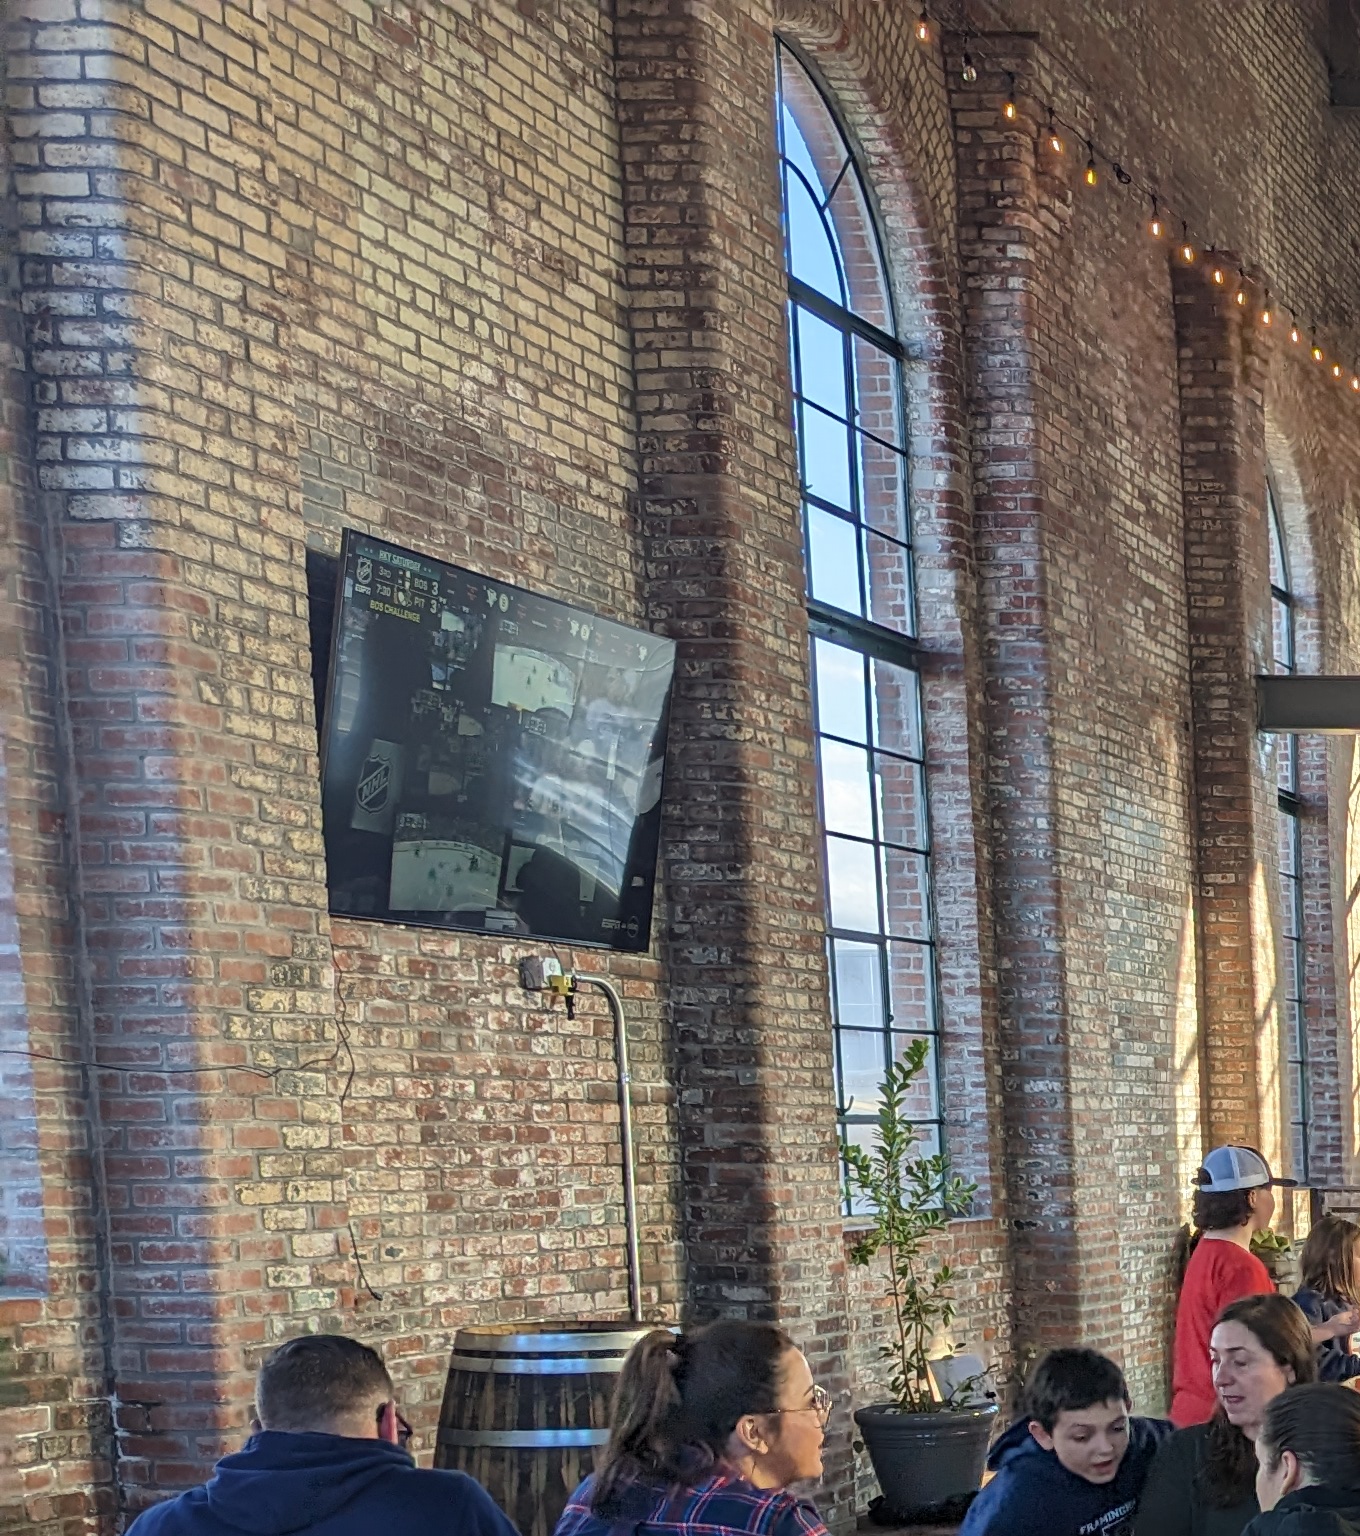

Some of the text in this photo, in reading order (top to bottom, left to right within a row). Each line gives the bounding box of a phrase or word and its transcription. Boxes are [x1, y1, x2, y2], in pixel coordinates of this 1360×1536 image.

[392, 555, 421, 572] SATURDAY
[414, 578, 428, 591] BOS
[431, 582, 439, 596] 3
[384, 604, 421, 624] CHALLENGE
[414, 596, 426, 608] PIT
[430, 600, 437, 614] 3
[362, 769, 387, 801] NHL
